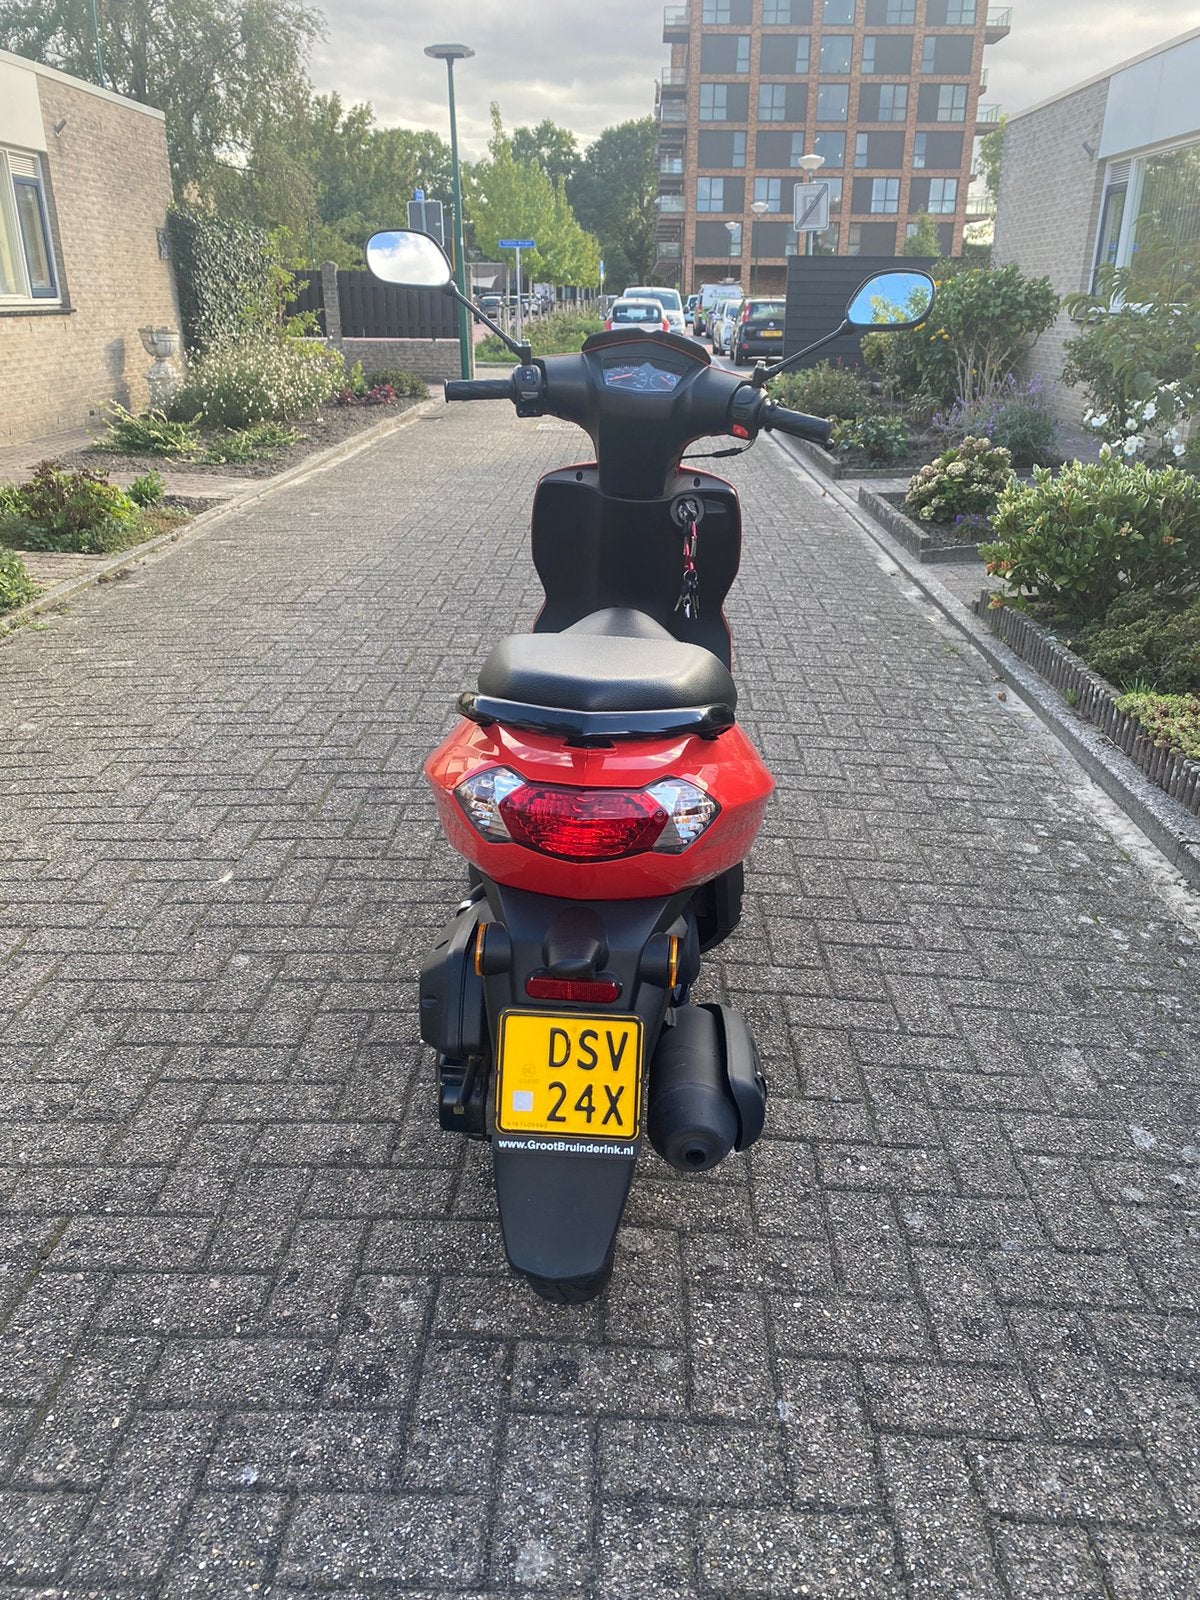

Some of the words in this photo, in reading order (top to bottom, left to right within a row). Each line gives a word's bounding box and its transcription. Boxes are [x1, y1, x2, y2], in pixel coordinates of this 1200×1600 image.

[548, 1027, 629, 1072] DSV
[546, 1080, 625, 1126] 24X
[498, 1139, 634, 1156] www.GrootBruinderink.nl
